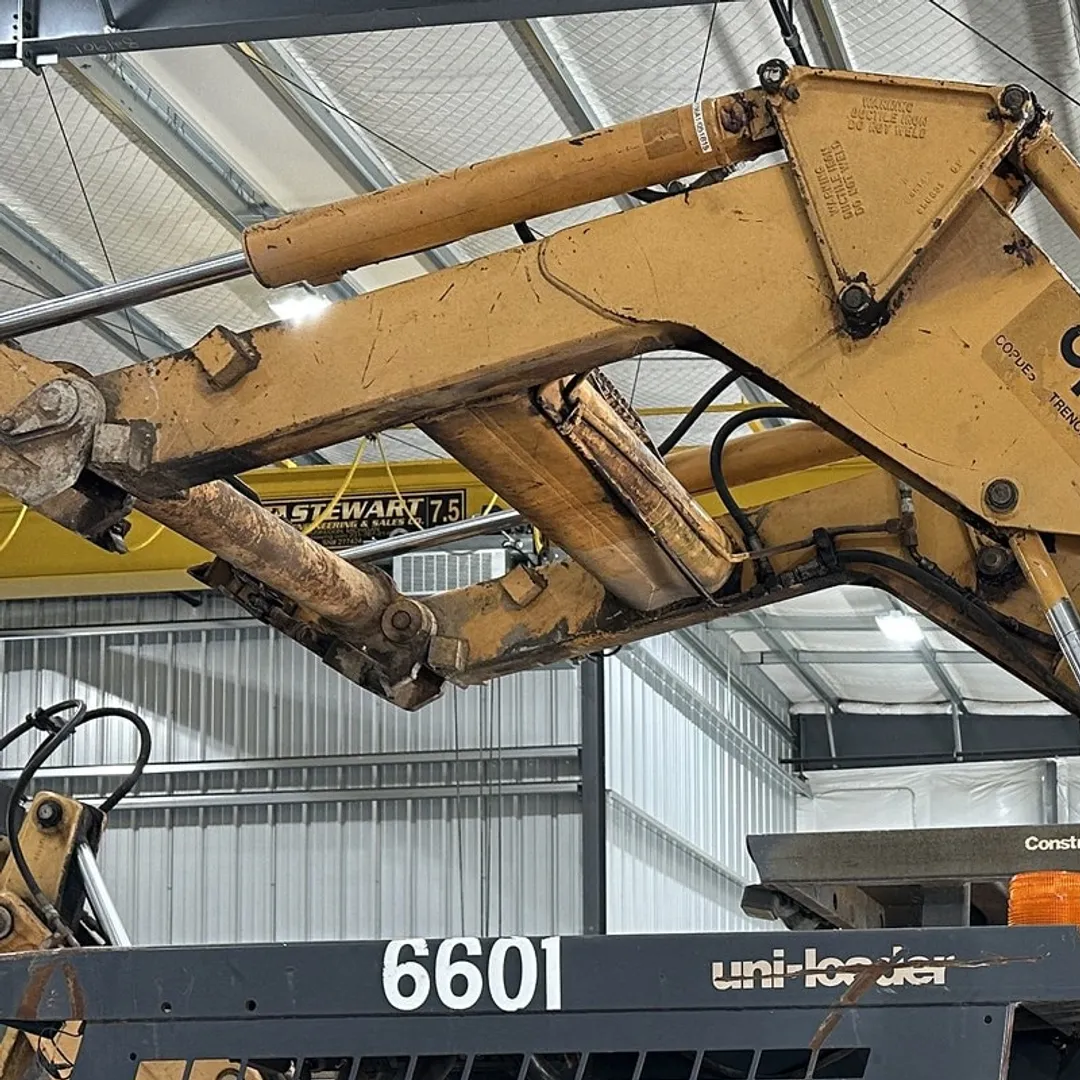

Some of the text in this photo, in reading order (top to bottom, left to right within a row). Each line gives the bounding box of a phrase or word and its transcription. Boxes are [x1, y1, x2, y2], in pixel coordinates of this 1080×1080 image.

[291, 498, 461, 523] STEWART 7.5
[382, 936, 562, 1012] 6601
